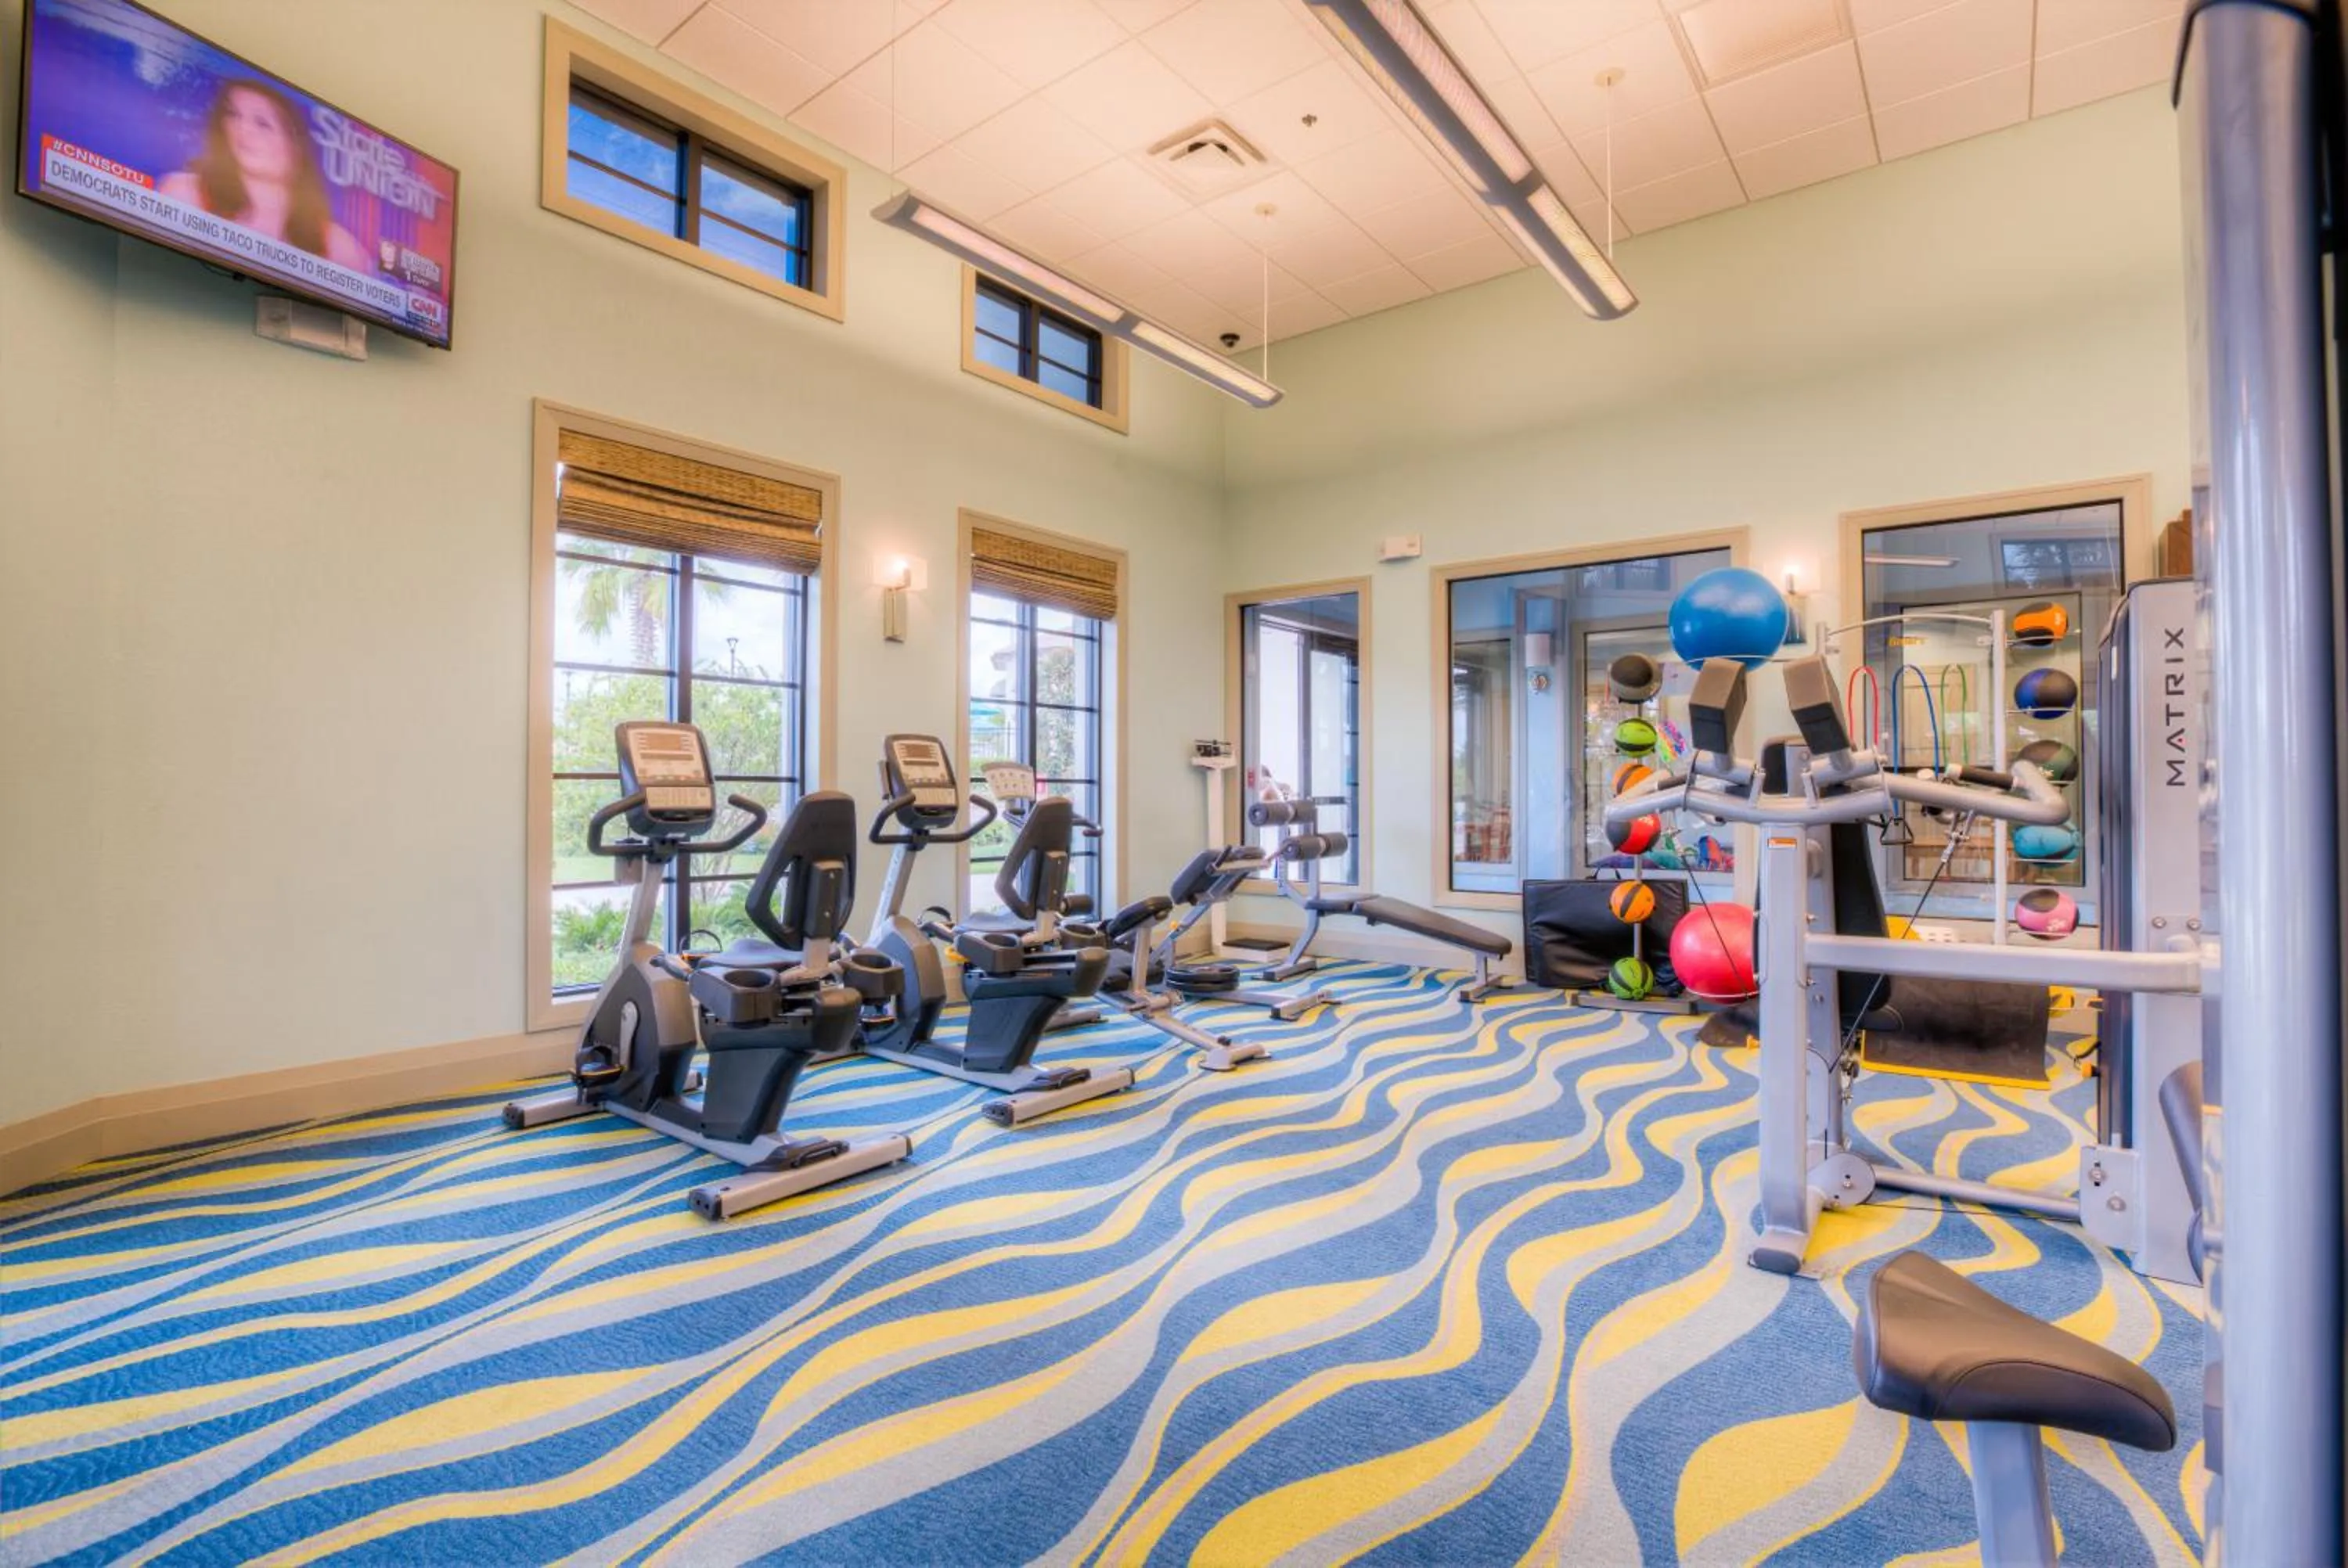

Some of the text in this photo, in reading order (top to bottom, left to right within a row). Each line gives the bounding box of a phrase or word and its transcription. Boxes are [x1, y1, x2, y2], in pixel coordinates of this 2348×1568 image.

[52, 139, 144, 183] #CNNSOTU
[51, 160, 401, 307] DEMOCRATS START USING TACO TRUCKS TO REGISTER VOTERS
[411, 298, 438, 319] CNN
[2165, 628, 2186, 786] MATRIX
